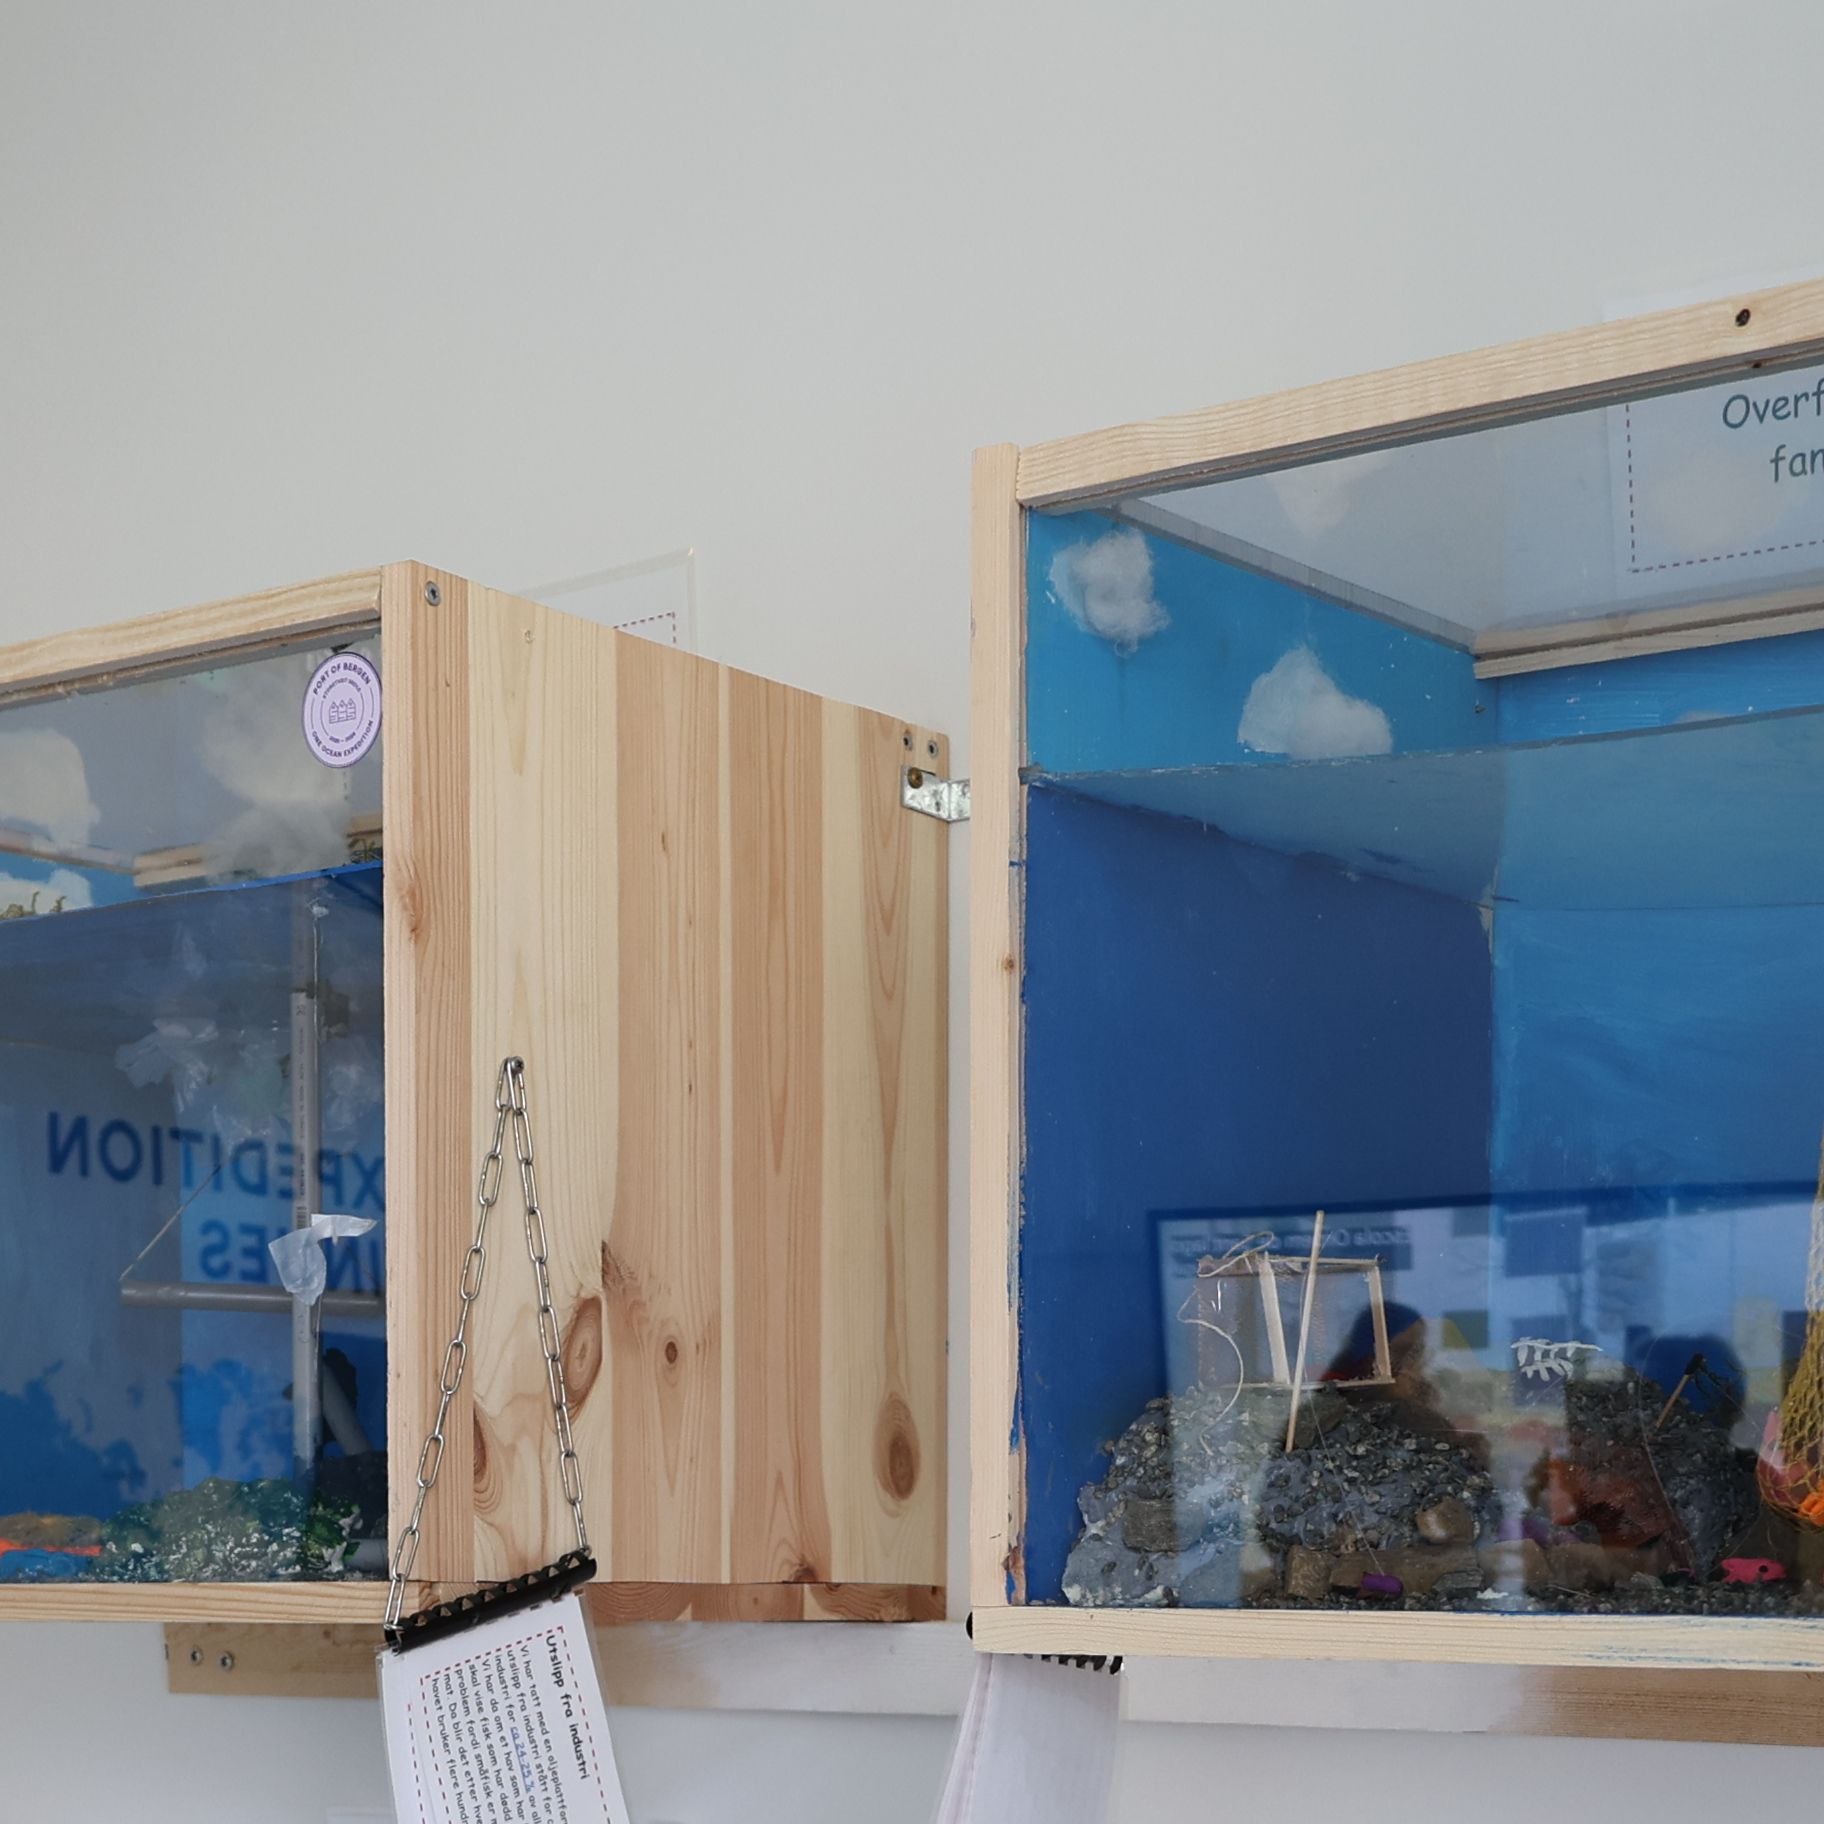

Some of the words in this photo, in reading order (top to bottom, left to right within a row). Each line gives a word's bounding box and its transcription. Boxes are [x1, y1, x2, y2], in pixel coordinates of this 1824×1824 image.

[313, 670, 330, 695] PORT
[331, 662, 342, 674] OF
[343, 661, 371, 685] BERGEN
[520, 1644, 529, 1657] Vi
[481, 1658, 490, 1671] Vi
[523, 1659, 533, 1679] har
[484, 1673, 494, 1694] har
[494, 1654, 511, 1700] industri
[489, 1698, 499, 1712] da
[528, 1683, 541, 1706] tatt
[505, 1703, 515, 1722] for
[545, 1634, 564, 1687] Utslipp
[559, 1693, 572, 1717] fra
[568, 1722, 590, 1779] industri
[494, 1715, 503, 1732] om
[506, 1649, 521, 1689] utslipp
[516, 1692, 526, 1712] fra
[522, 1714, 541, 1759] industri
[535, 1763, 548, 1791] stått
[542, 1796, 551, 1814] for
[536, 1710, 550, 1735] med
[453, 1668, 470, 1716] problem
[465, 1719, 480, 1749] fordi
[474, 1753, 493, 1798] småfisk
[487, 1801, 495, 1814] er
[468, 1664, 480, 1687] skal
[474, 1689, 483, 1713] vise
[479, 1716, 492, 1740] fisk
[486, 1743, 497, 1766] som
[493, 1768, 504, 1788] har
[499, 1792, 513, 1821] dødd
[499, 1735, 508, 1747] et
[510, 1726, 519, 1741] ca
[543, 1738, 551, 1752] en
[503, 1750, 514, 1771] hav
[514, 1742, 531, 1779] 24-25
[509, 1775, 520, 1798] som
[516, 1799, 524, 1819] har
[528, 1795, 536, 1807] av
